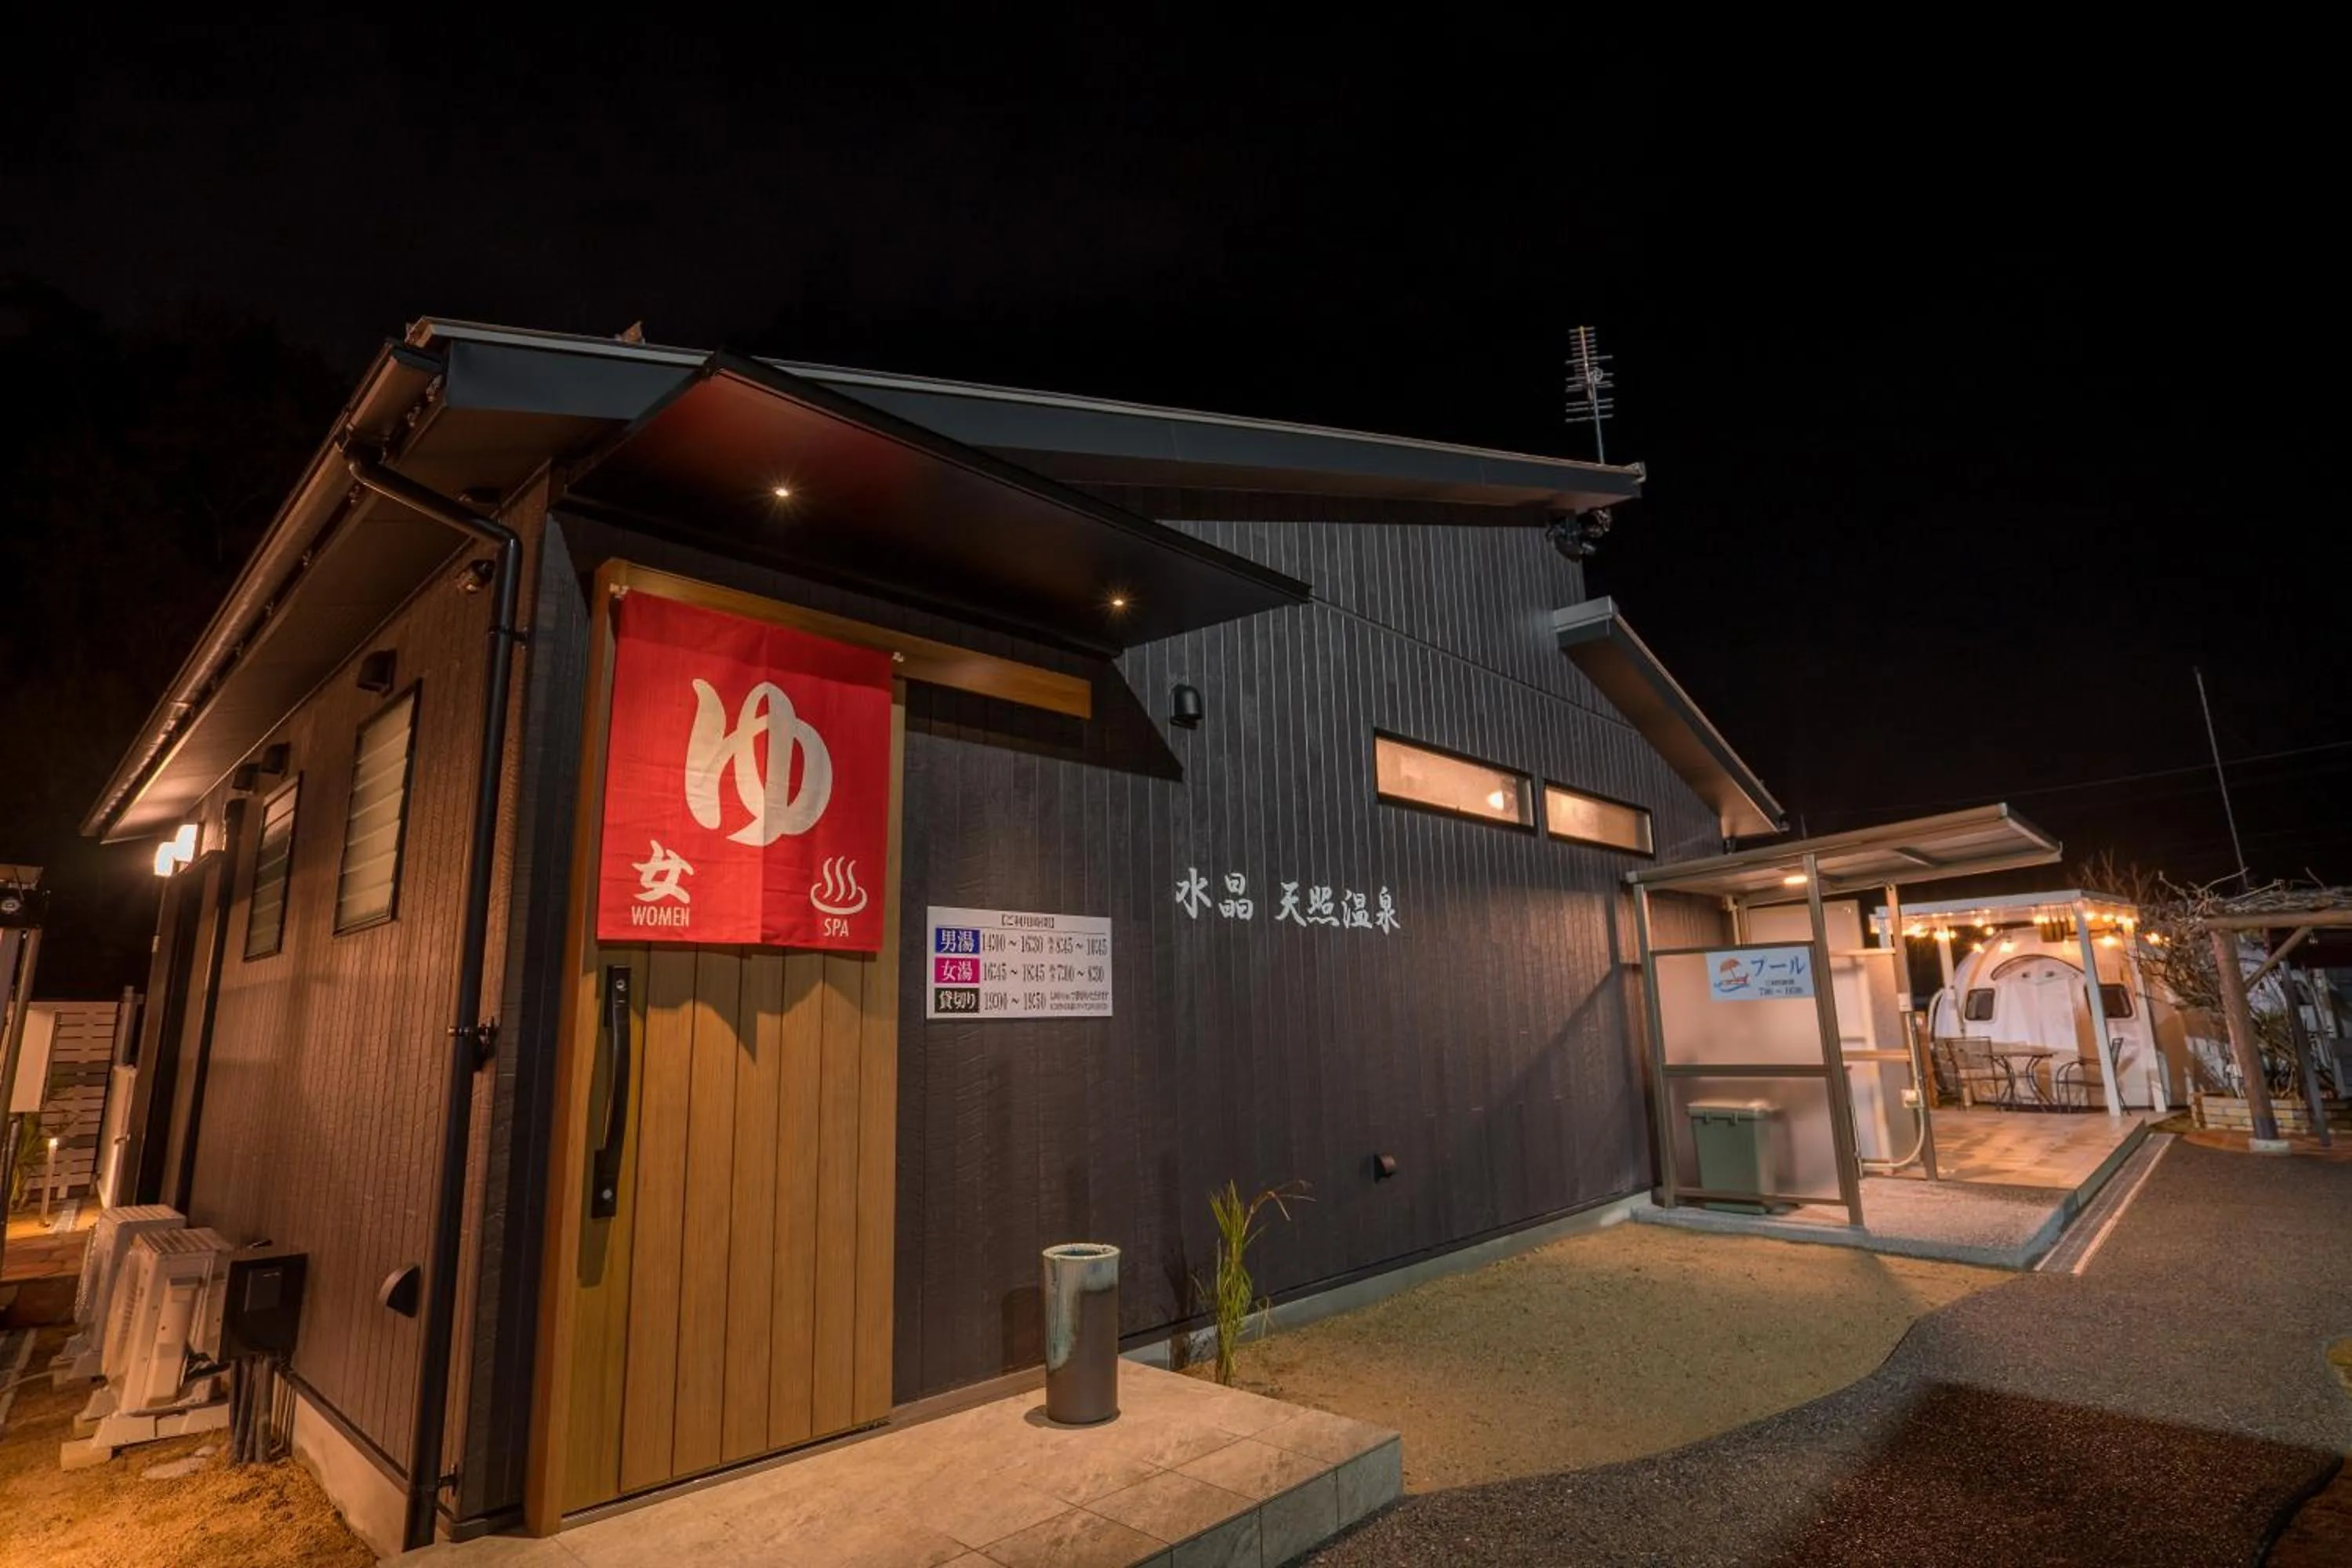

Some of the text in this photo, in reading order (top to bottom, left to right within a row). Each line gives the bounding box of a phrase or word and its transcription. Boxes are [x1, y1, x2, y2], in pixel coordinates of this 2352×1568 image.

[684, 678, 833, 847] ゆ
[631, 840, 694, 903] 女
[1176, 867, 1400, 935] 水晶 天照温泉
[631, 906, 689, 927] WOMEN
[823, 918, 849, 937] SPA
[941, 930, 974, 953] 男湯
[942, 960, 974, 982] 女湯
[1750, 955, 1806, 977] プール
[938, 990, 976, 1011] 貸切り
